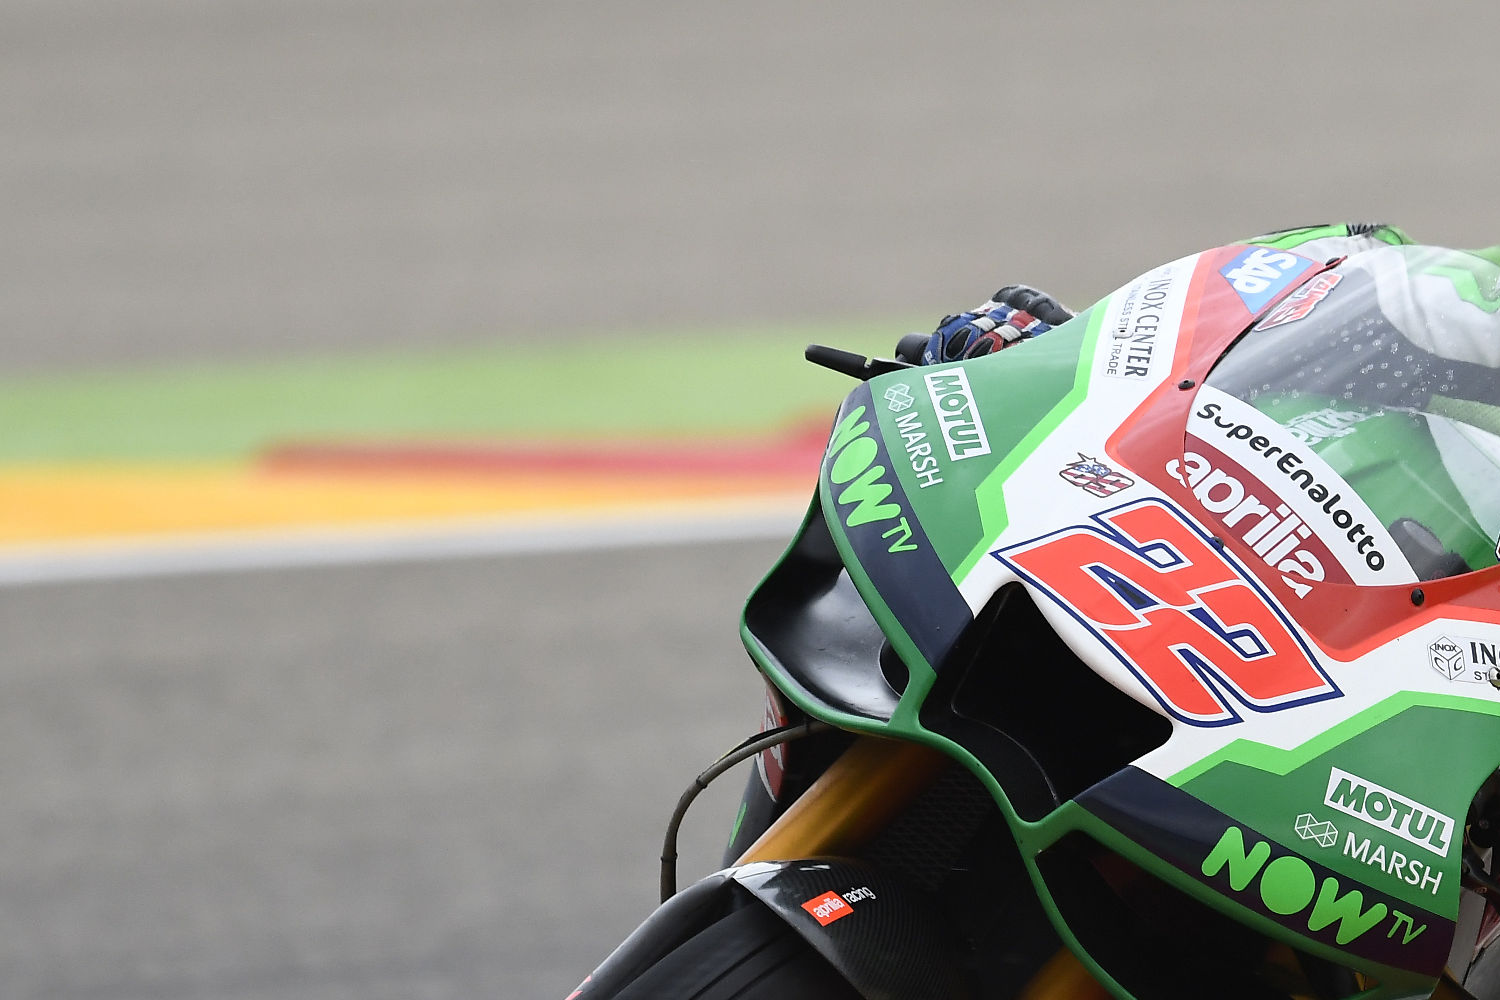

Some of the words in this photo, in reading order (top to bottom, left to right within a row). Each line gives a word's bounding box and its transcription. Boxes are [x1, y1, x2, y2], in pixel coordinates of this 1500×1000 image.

[1140, 278, 1173, 311] INOX
[1225, 248, 1298, 295] SAP
[1106, 343, 1123, 375] TRADE
[1124, 314, 1160, 377] CENTER
[895, 412, 943, 489] MARSH
[927, 372, 985, 458] MOTUL
[829, 405, 901, 528] NOW
[881, 517, 918, 554] TV
[1196, 402, 1386, 572] SuperEnalotto
[1165, 451, 1327, 600] aprilia
[989, 496, 1345, 728] 22
[1330, 776, 1447, 851] MOTUL
[1201, 826, 1389, 945] NOW
[1387, 909, 1427, 945] TV
[1343, 831, 1444, 895] MARSH
[813, 897, 846, 919] aprilia
[841, 886, 877, 905] racing
